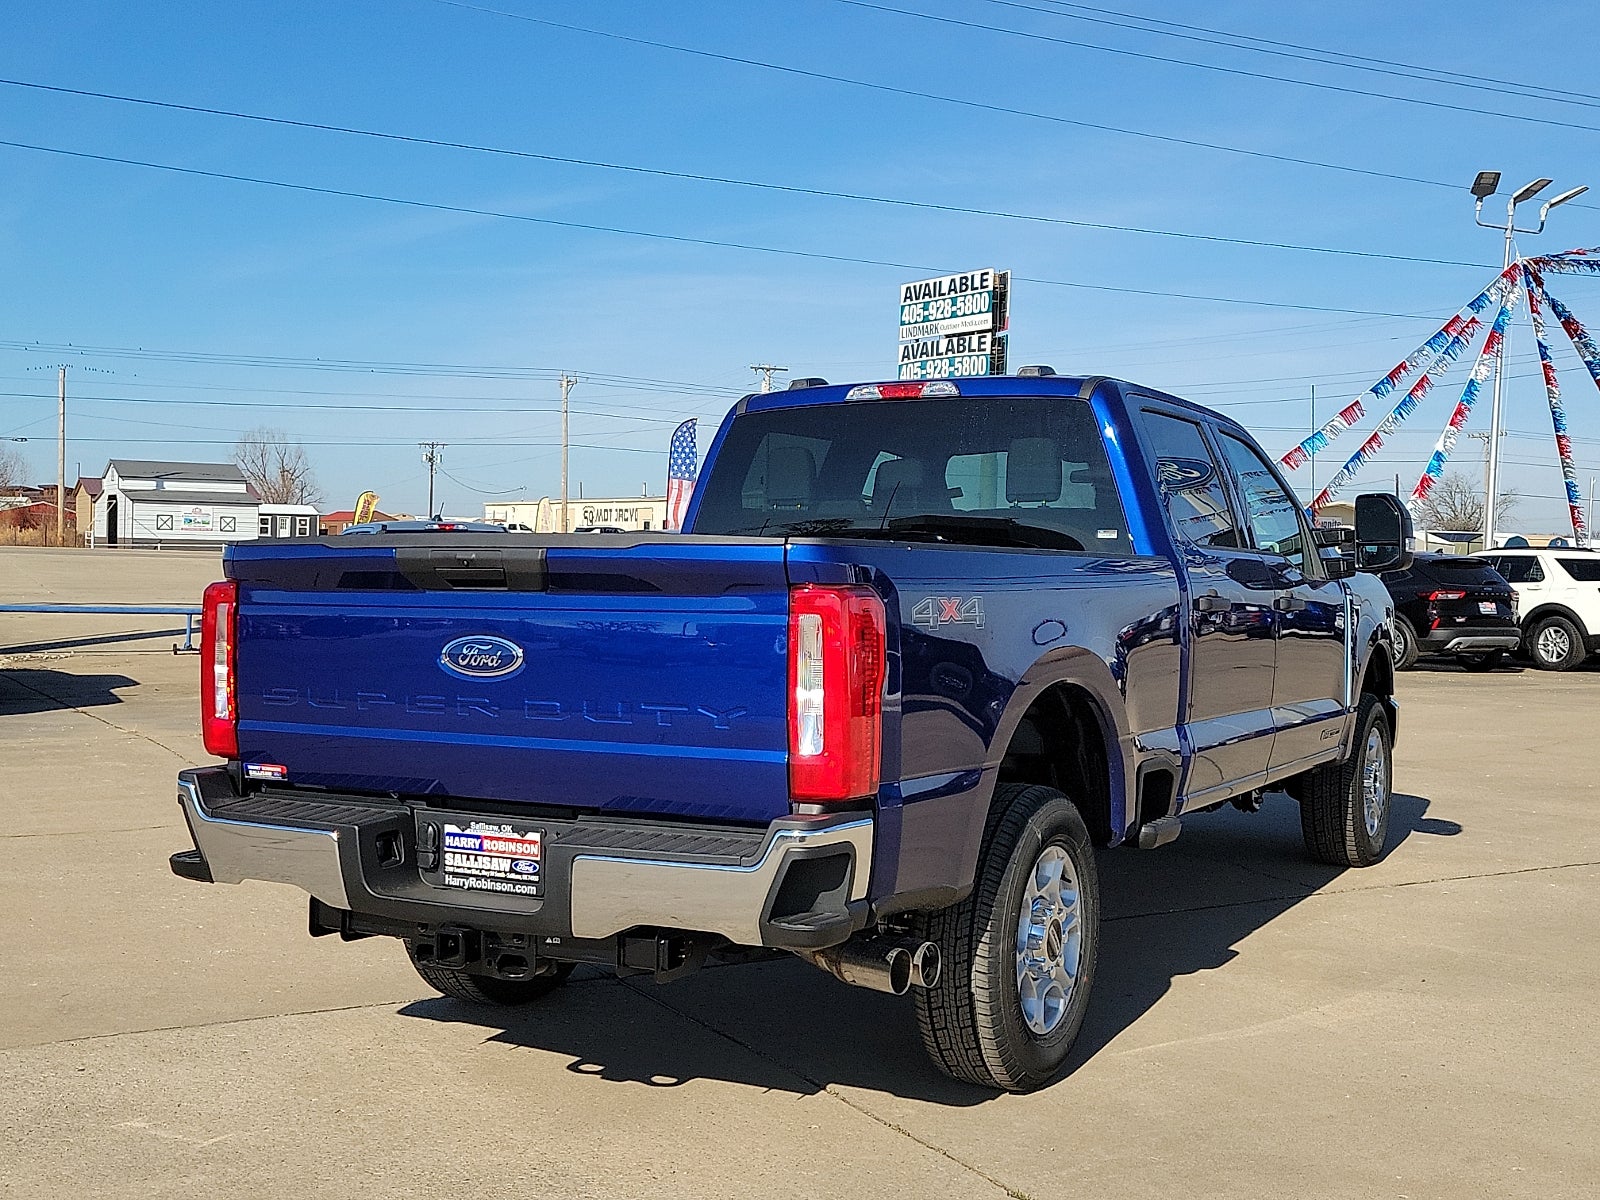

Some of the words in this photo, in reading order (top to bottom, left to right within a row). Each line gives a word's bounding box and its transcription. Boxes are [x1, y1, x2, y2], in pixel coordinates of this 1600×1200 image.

[903, 271, 990, 303] AVAILABLE
[901, 291, 990, 324] 405-928-5800
[901, 322, 940, 339] LINDMARK
[901, 334, 988, 362] AVAILABLE
[899, 355, 987, 379] 405-928-5800
[263, 687, 500, 717] SUPER
[524, 700, 749, 730] DUTY
[501, 824, 513, 834] OK
[445, 835, 482, 850] HARRY
[483, 839, 539, 855] ROBINSON
[444, 852, 512, 872] SALLISAW
[444, 874, 537, 895] HarryRobinson.com
